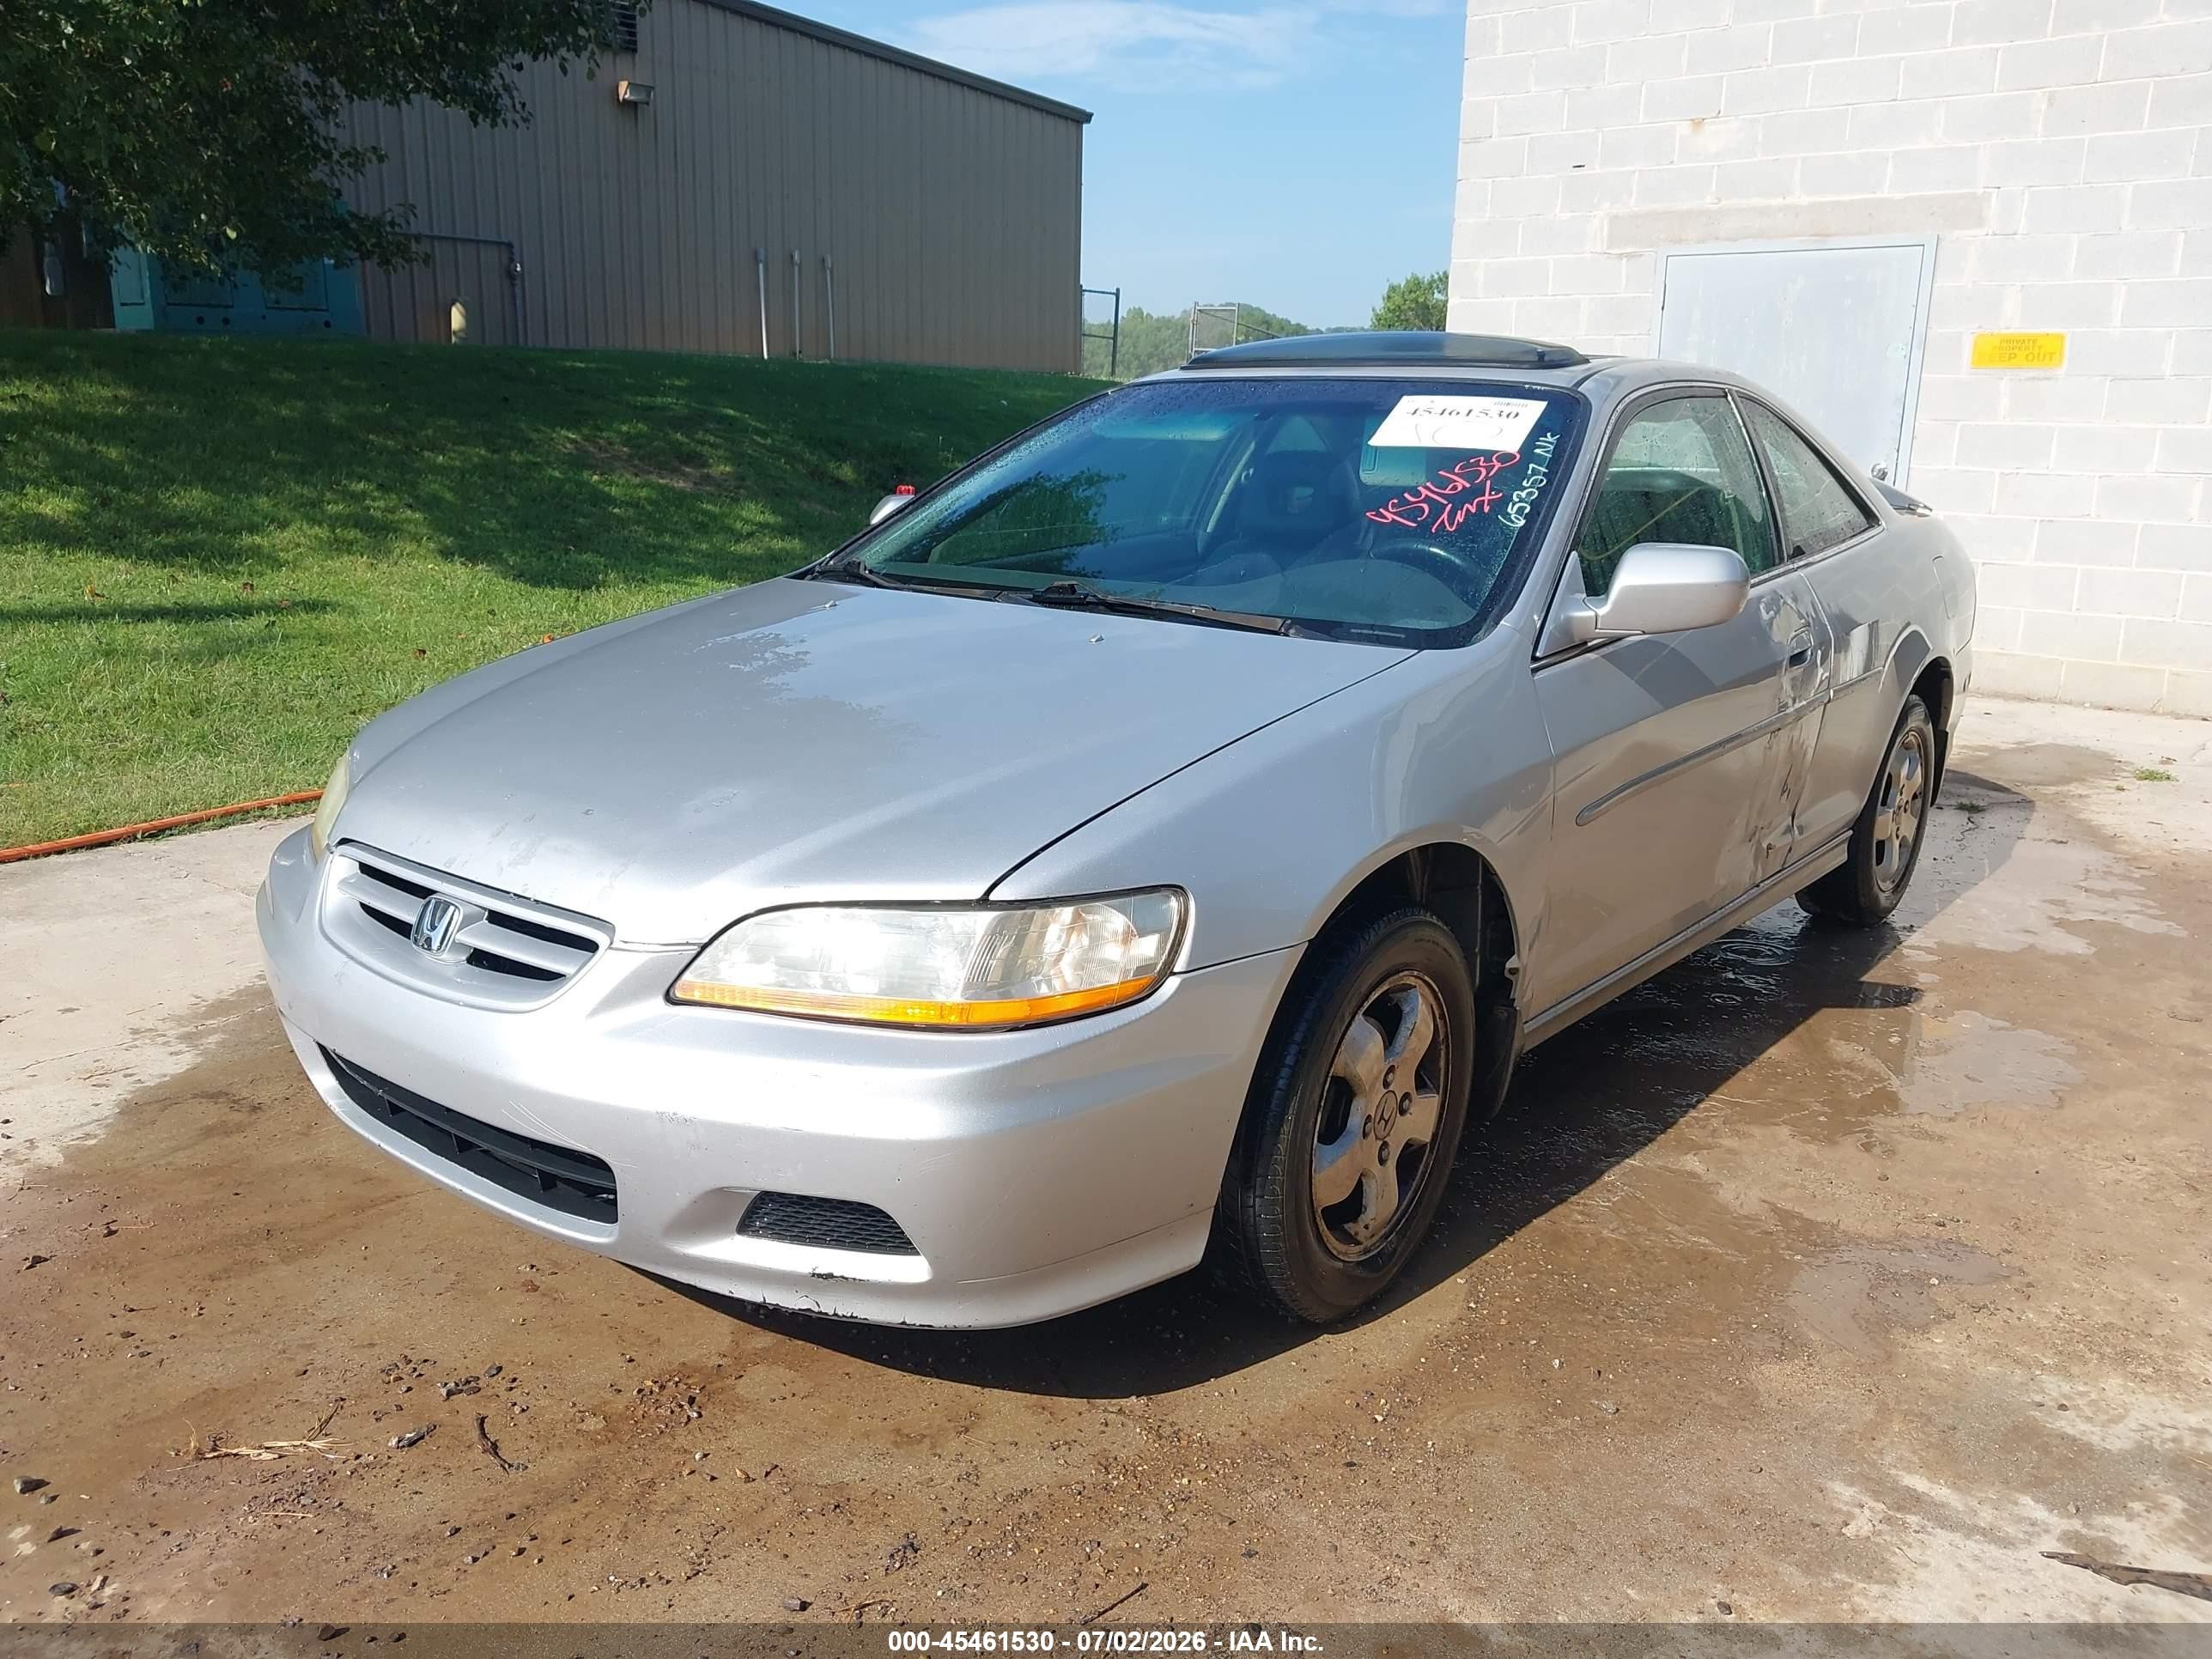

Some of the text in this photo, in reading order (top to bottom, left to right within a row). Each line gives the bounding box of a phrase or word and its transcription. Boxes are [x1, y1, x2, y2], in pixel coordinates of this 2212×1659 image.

[2025, 352, 2057, 362] OUT
[1407, 407, 1521, 420] 45461530
[1498, 463, 1549, 528] 65357
